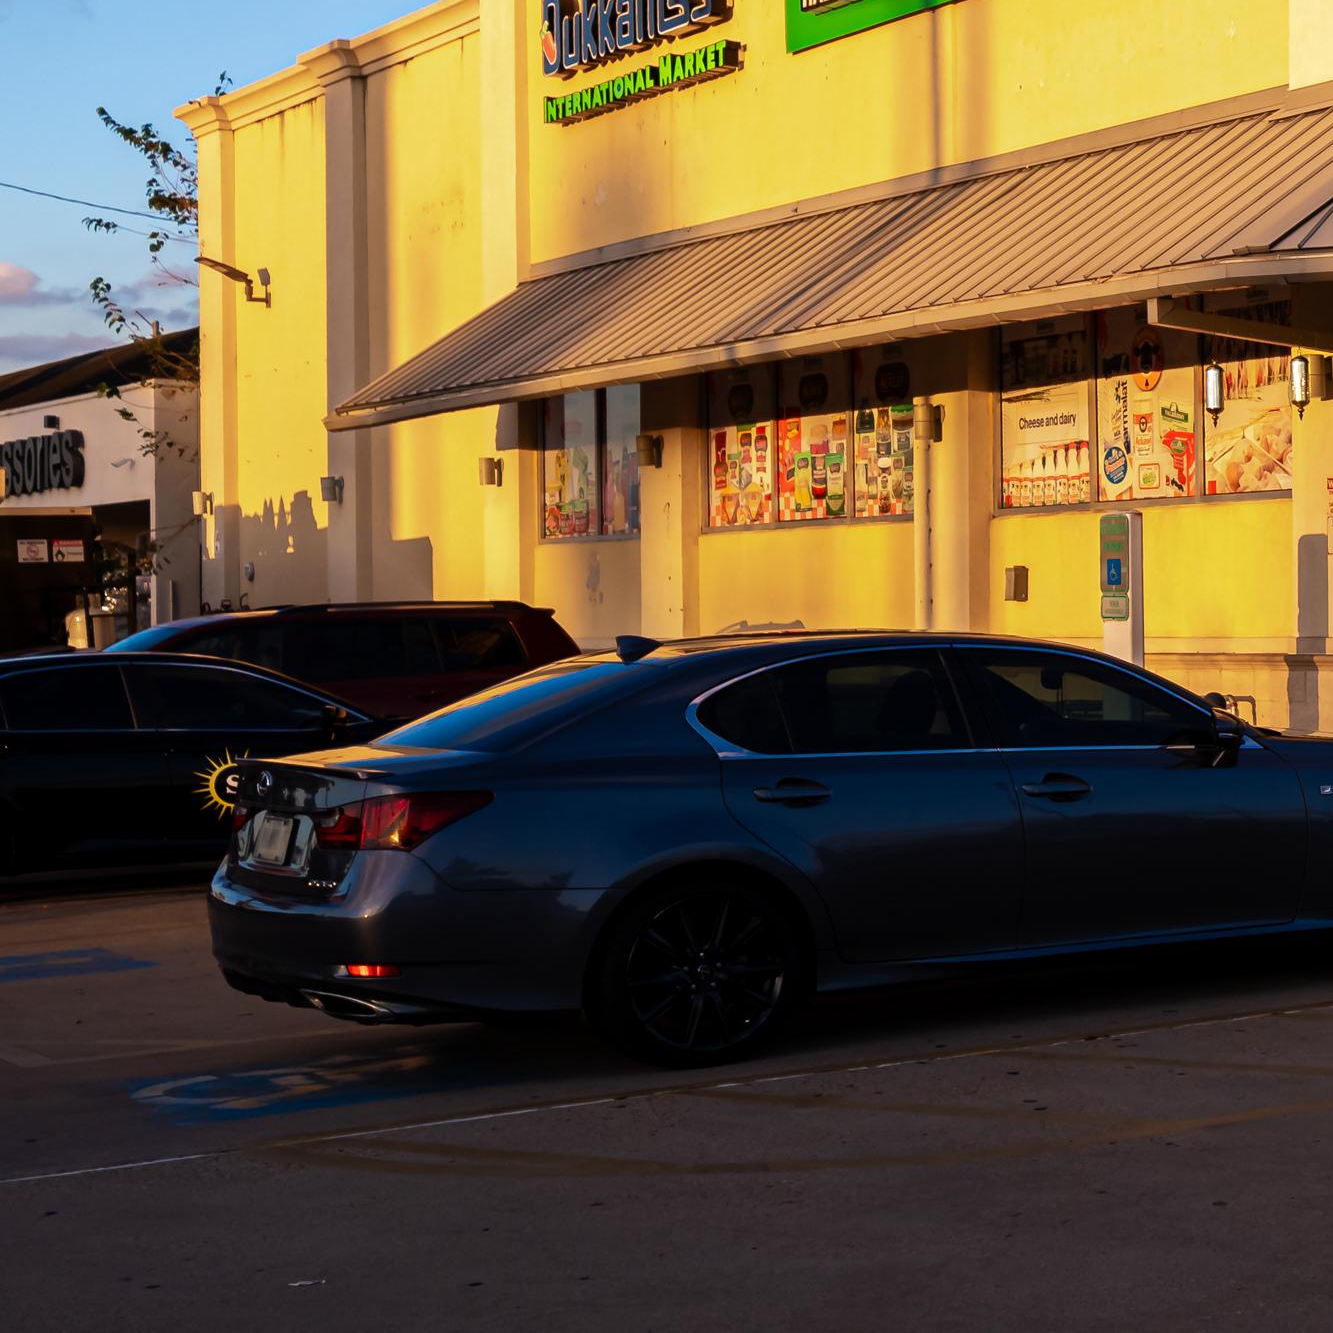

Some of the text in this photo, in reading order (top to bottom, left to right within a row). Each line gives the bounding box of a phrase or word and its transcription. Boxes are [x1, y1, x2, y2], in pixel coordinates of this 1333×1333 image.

[544, 41, 727, 124] INTERNATIONAL MARKET
[1019, 411, 1076, 430] Cheese and dairy
